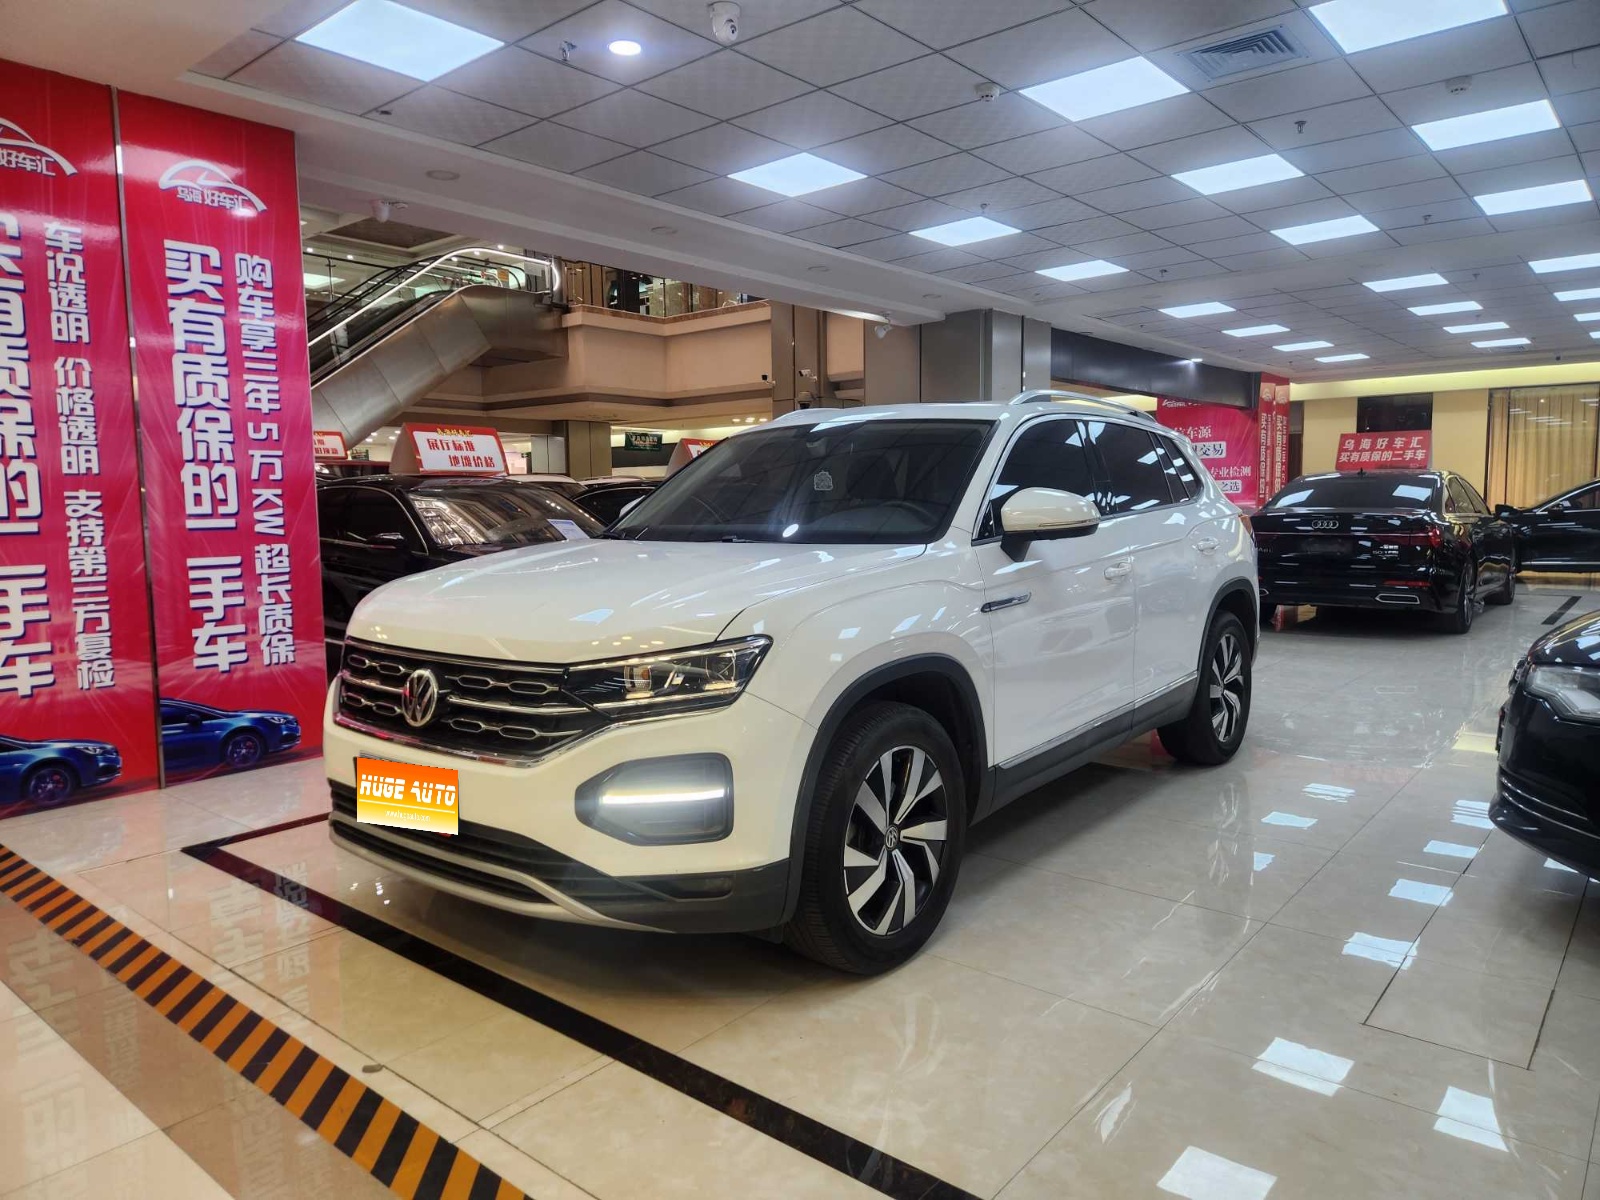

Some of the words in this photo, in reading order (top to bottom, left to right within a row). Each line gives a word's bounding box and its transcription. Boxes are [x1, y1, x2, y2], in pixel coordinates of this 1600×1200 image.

[44, 221, 86, 343] 车况透明
[54, 356, 100, 475] 价格透明
[163, 238, 248, 672] 买有质保的二手车
[1339, 449, 1427, 463] 买有质保的二手车
[1343, 436, 1424, 450] 乌海好车汇
[64, 489, 115, 690] 支持第三方复检
